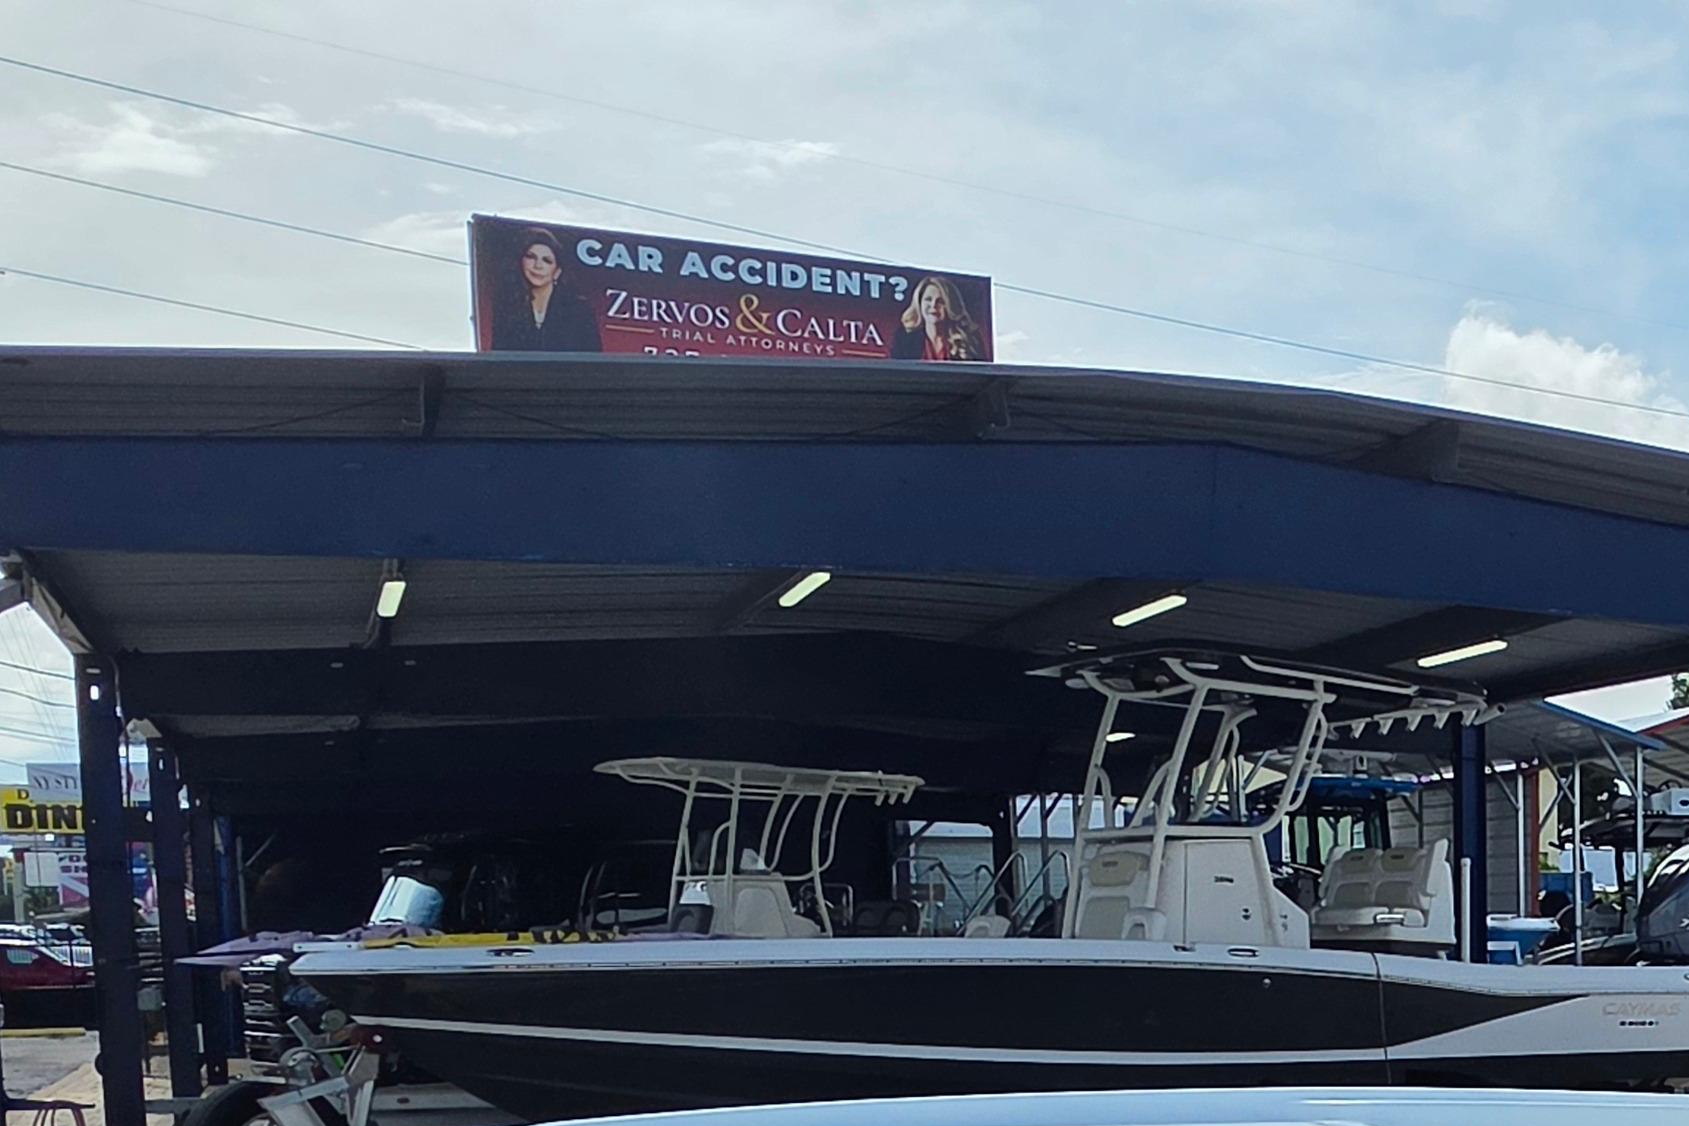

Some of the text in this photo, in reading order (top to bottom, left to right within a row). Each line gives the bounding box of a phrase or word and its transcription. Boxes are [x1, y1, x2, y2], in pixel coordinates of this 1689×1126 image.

[575, 238, 909, 301] CAR ACCIDENT?
[605, 288, 884, 346] ZERVOS & CALTA
[659, 327, 716, 344] TRIAL
[726, 335, 835, 357] ATTORNEYS
[5, 804, 86, 830] DIN
